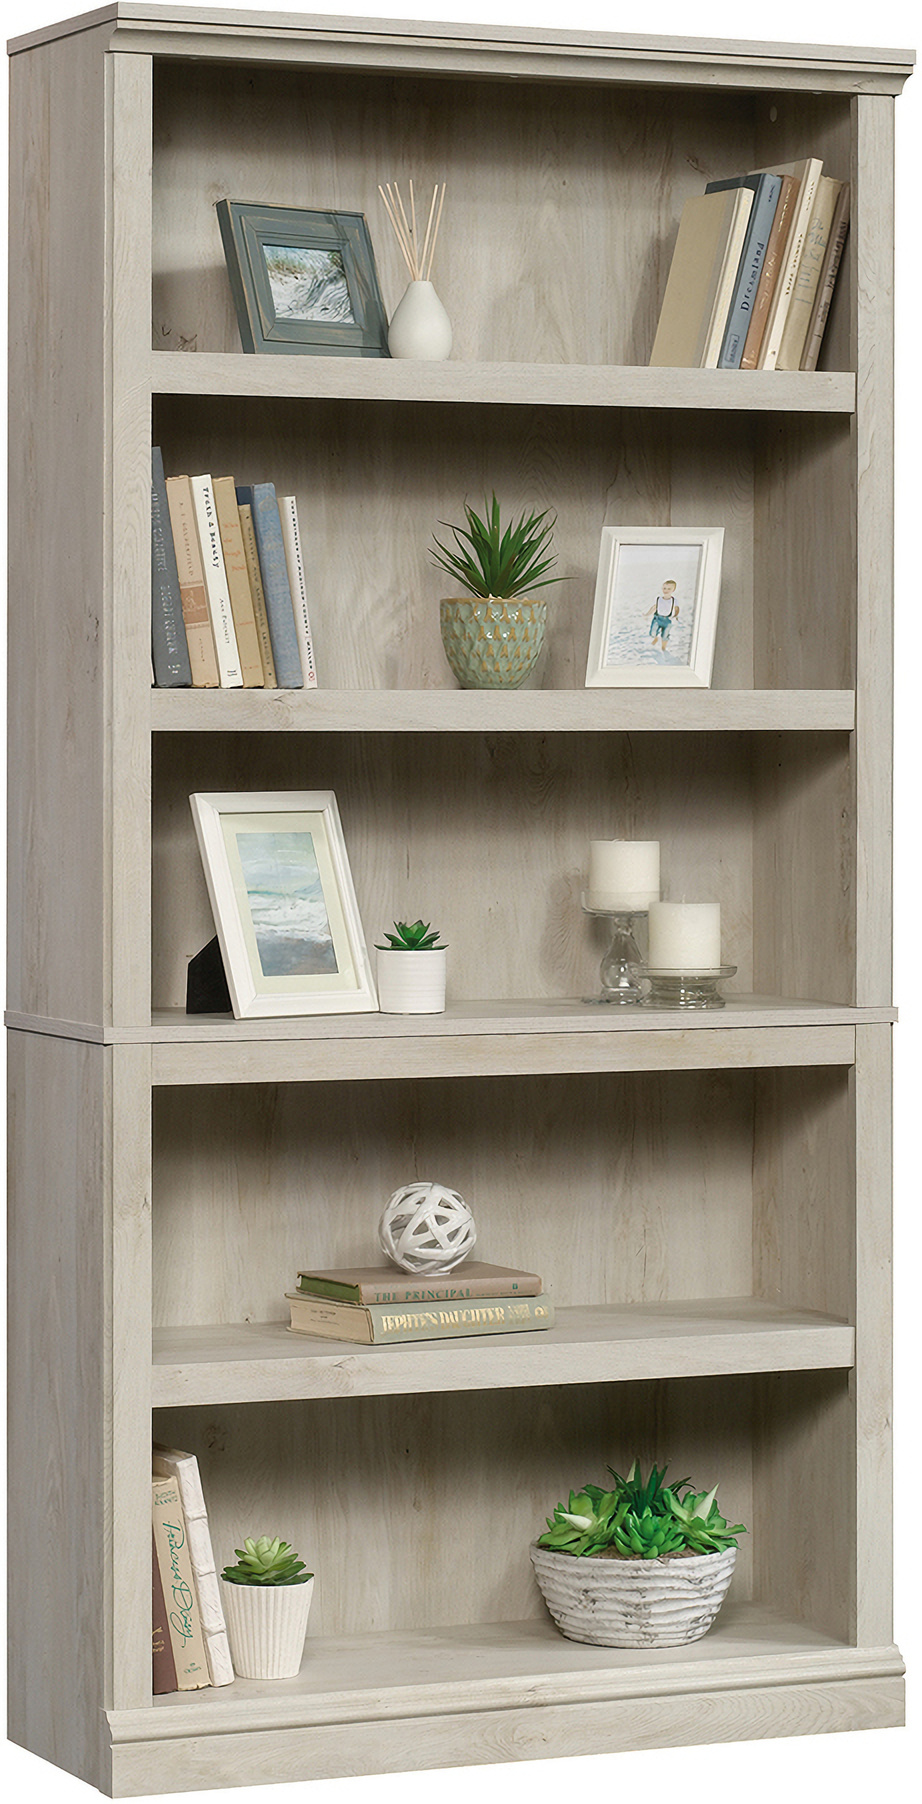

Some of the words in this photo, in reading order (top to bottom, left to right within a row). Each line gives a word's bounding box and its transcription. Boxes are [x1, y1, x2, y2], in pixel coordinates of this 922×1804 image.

[740, 242, 765, 312] Dreamland
[202, 487, 213, 518] Truth
[209, 532, 221, 568] Beauty
[374, 1292, 397, 1302] THE
[405, 1288, 473, 1301] PRINCIPAL
